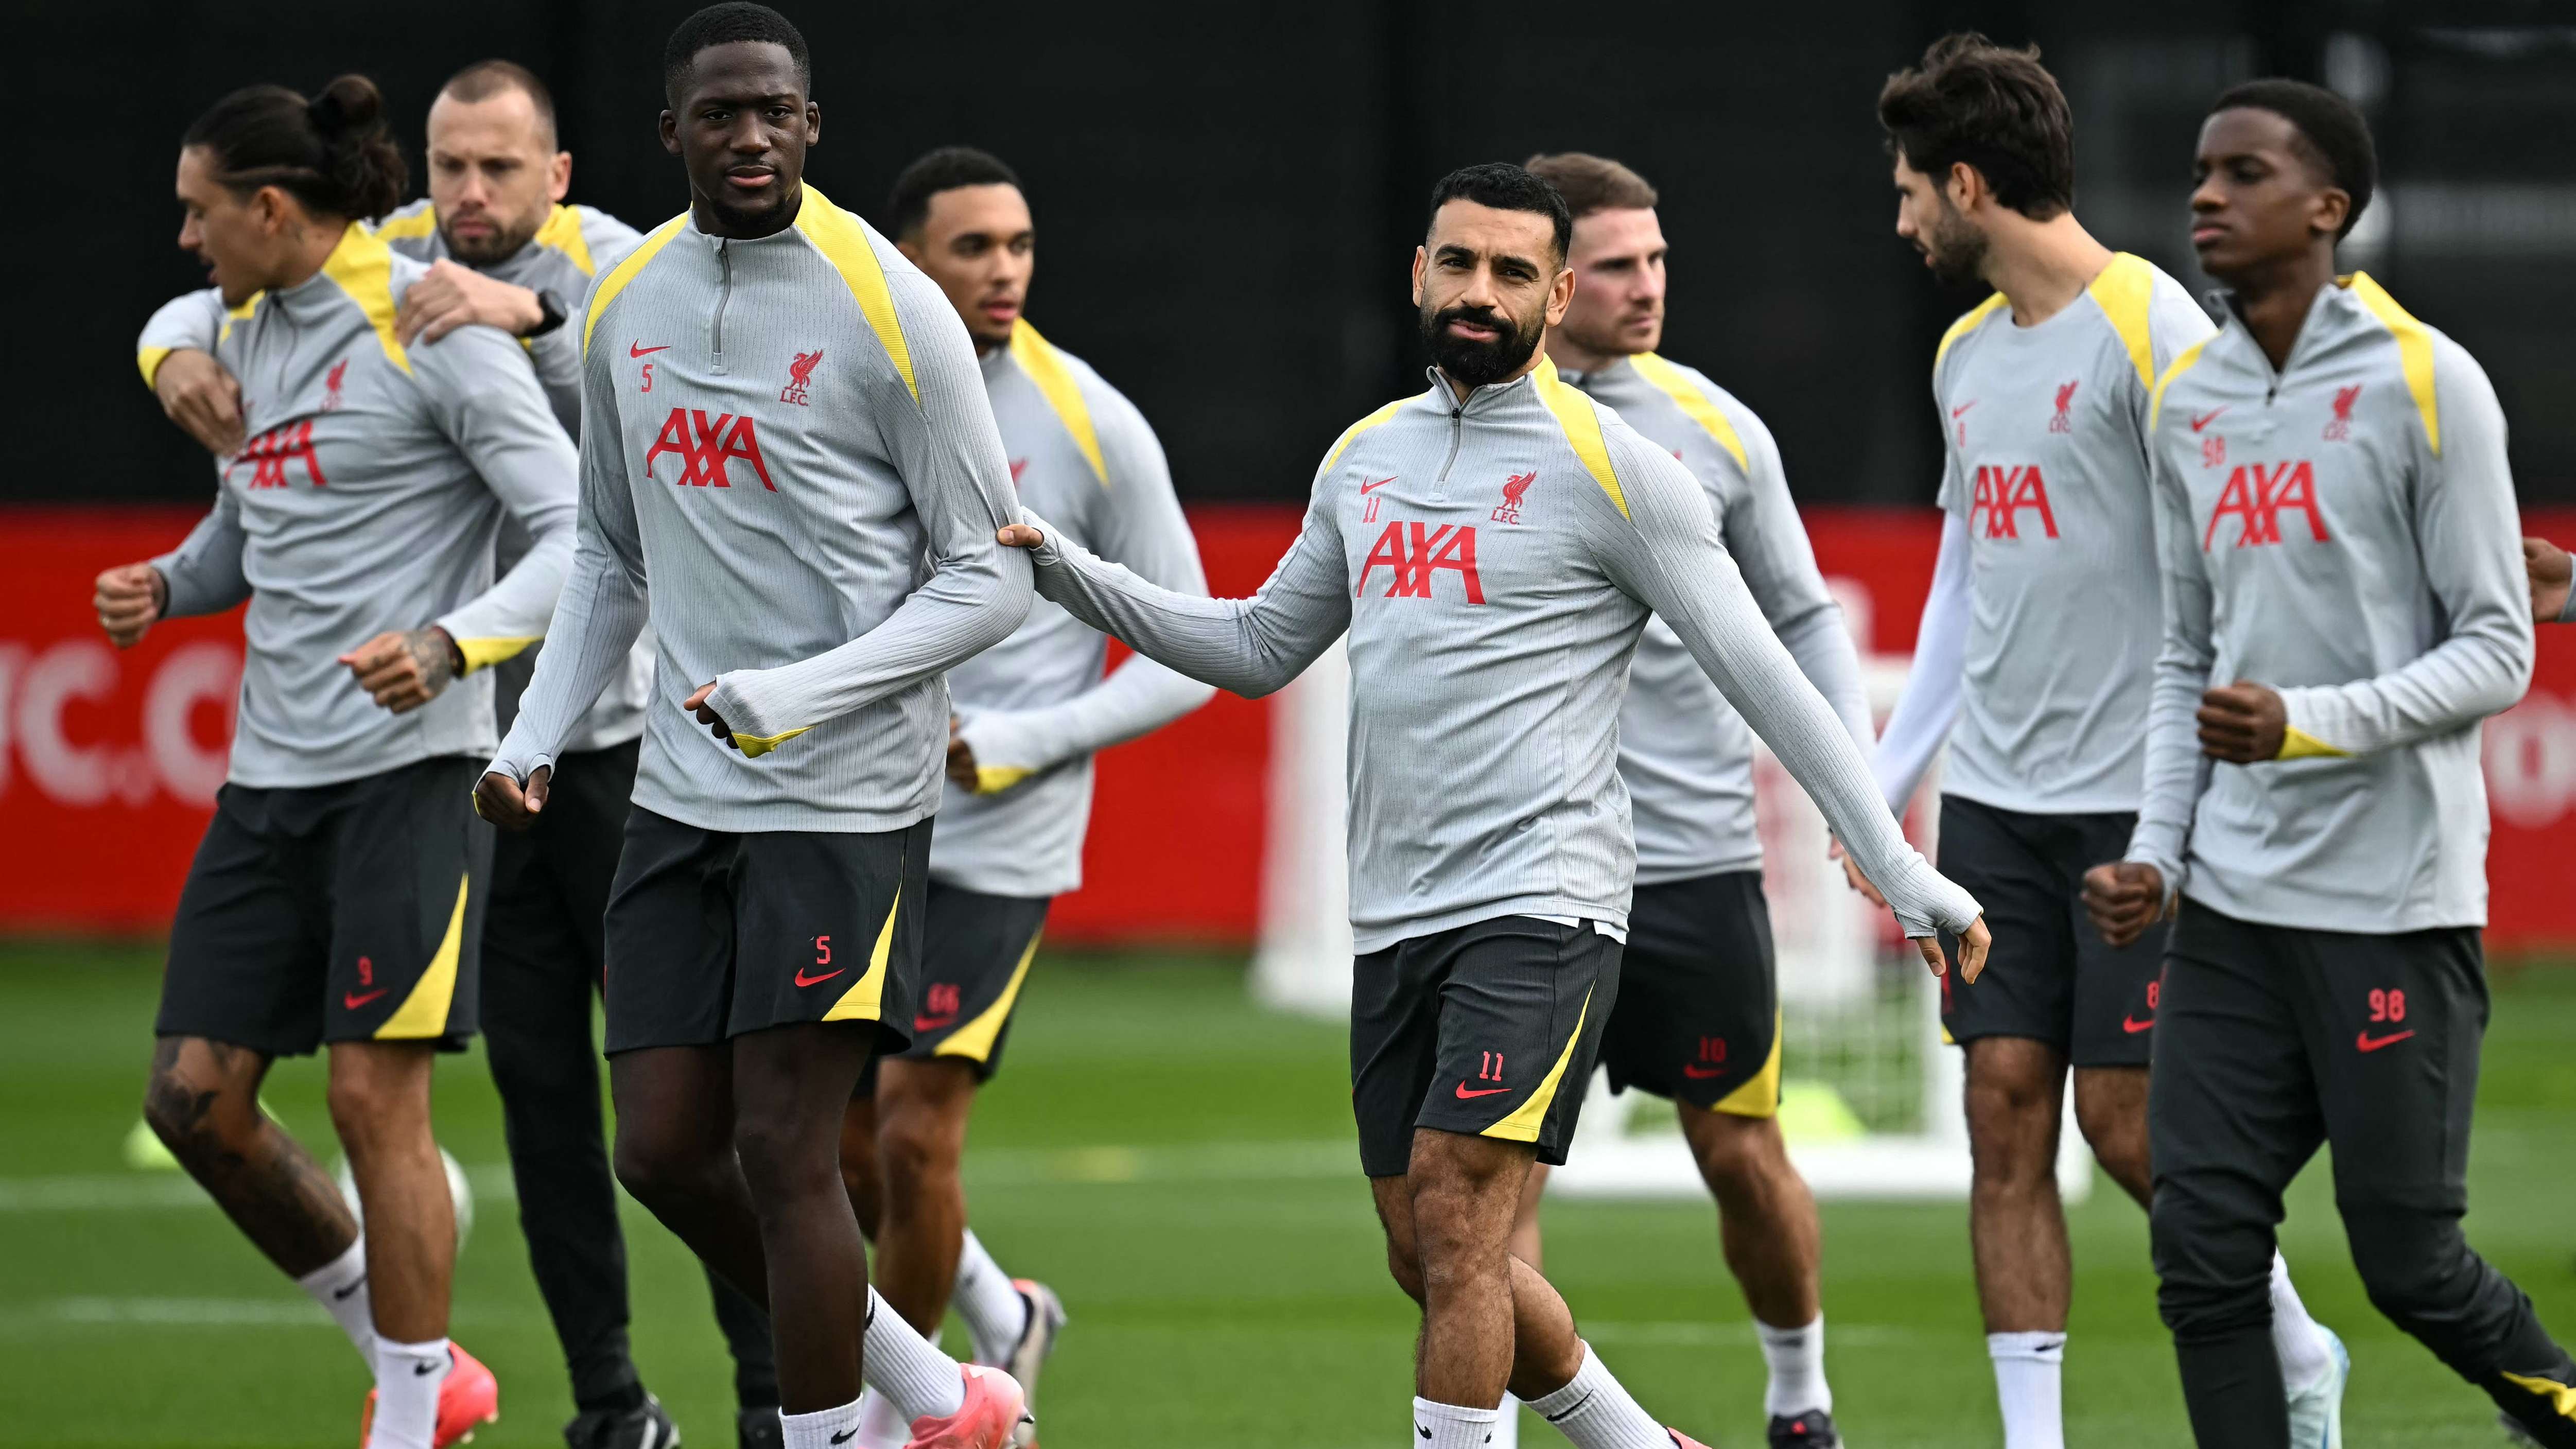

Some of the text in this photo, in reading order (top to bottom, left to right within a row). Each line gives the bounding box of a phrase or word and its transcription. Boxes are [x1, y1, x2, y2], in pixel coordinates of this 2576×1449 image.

[641, 364, 653, 392] 5
[646, 407, 778, 493] AXA
[1363, 497, 1381, 523] 11
[1968, 464, 2060, 539] AXA
[2204, 460, 2331, 553] AXA
[1356, 521, 1487, 605] AXA
[816, 935, 831, 964] 5
[2369, 987, 2406, 1022] 98
[1700, 1035, 1726, 1062] 10
[1479, 1051, 1504, 1081] 11
